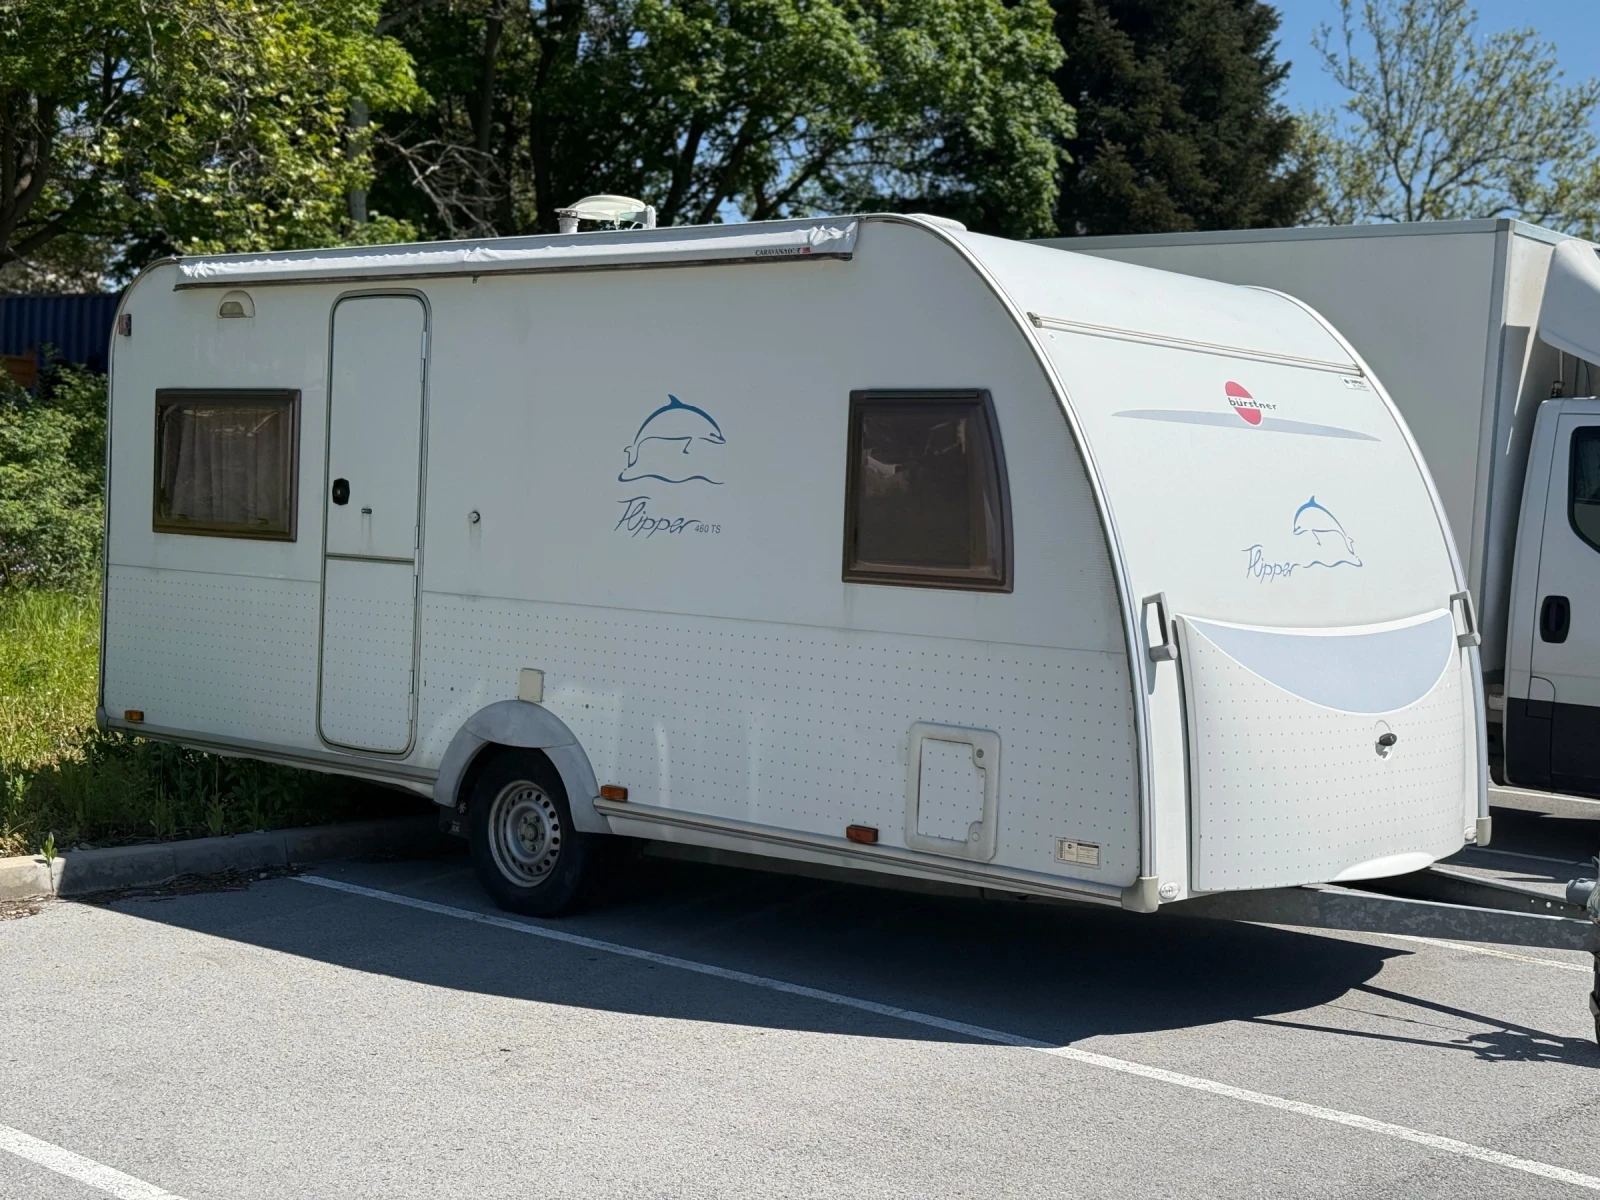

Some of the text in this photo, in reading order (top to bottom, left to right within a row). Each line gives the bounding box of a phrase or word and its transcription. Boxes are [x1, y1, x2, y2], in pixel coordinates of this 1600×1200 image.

[1227, 396, 1277, 411] bürstner
[614, 496, 721, 539] Flipper 460 TS
[1241, 544, 1301, 584] Flipper
